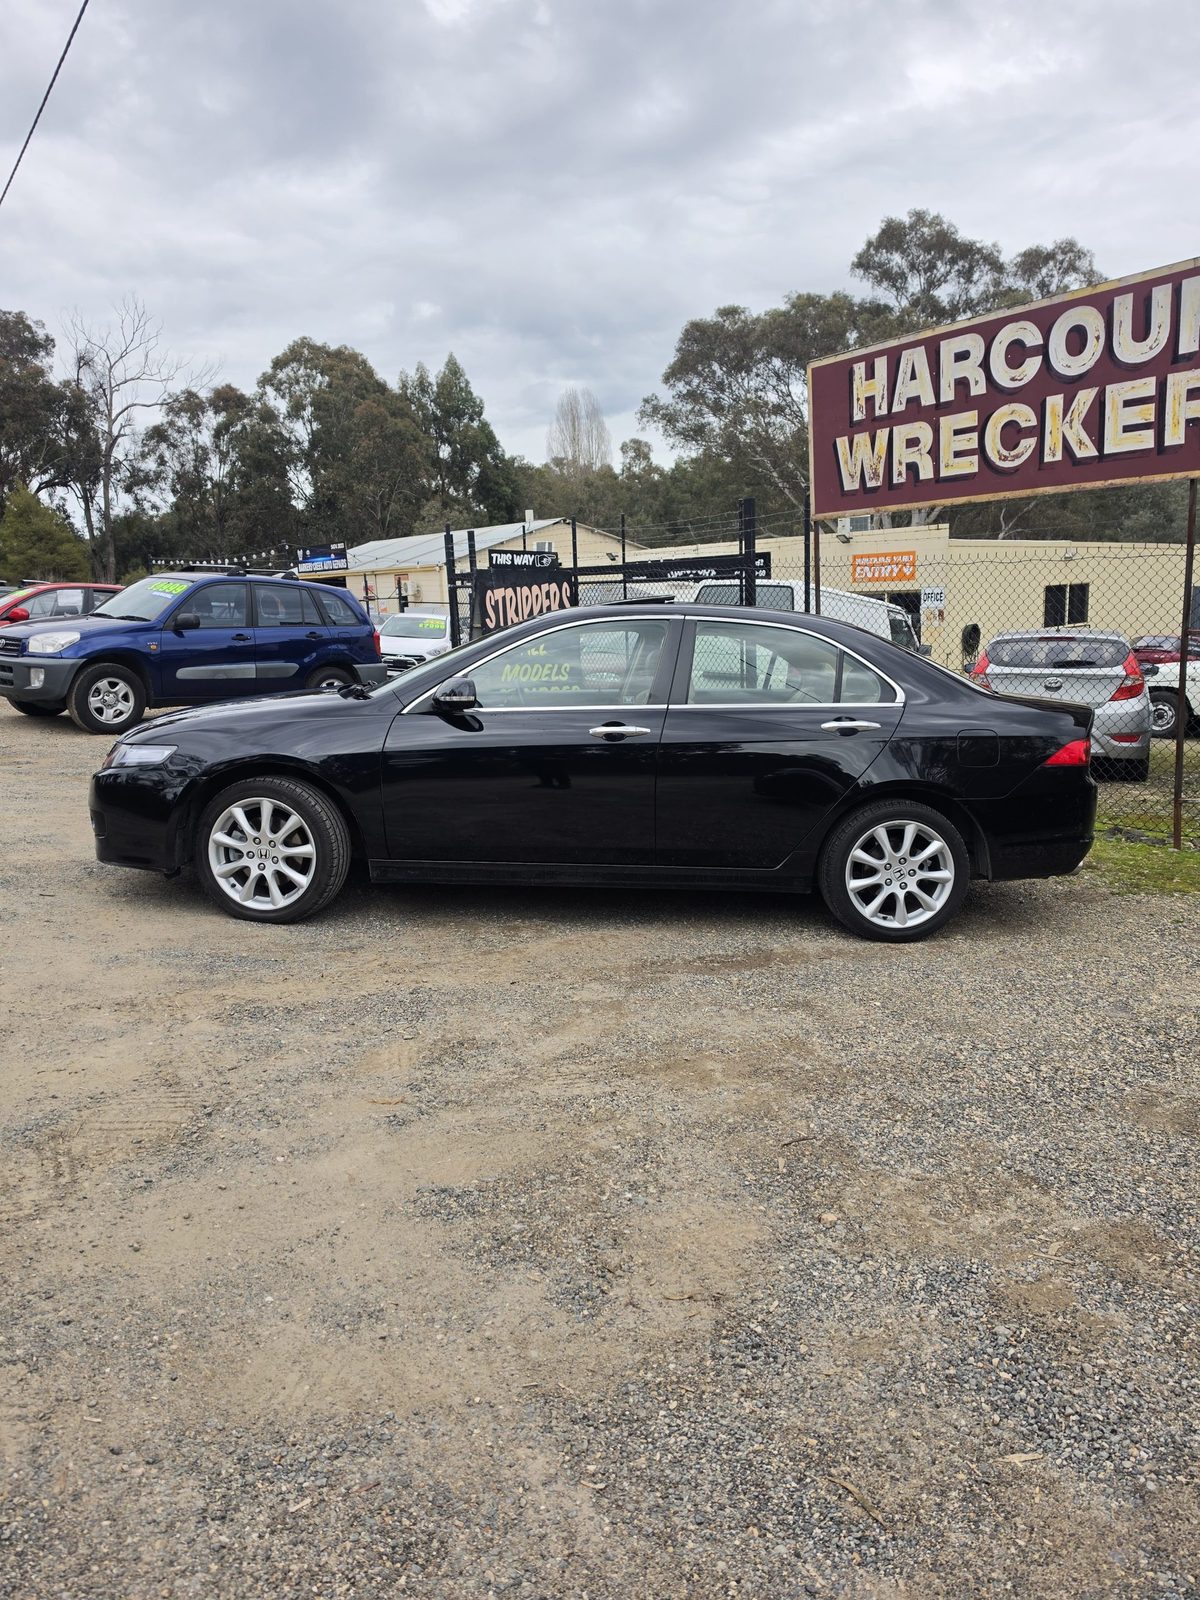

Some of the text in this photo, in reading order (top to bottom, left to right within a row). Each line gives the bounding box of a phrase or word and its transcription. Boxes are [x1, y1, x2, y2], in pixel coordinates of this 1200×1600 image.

[491, 553, 535, 566] THIS WAY
[855, 564, 901, 578] ENTRY
[923, 592, 943, 602] OFFICE
[485, 581, 571, 629] STRIPPERS
[501, 663, 570, 682] MODELS
